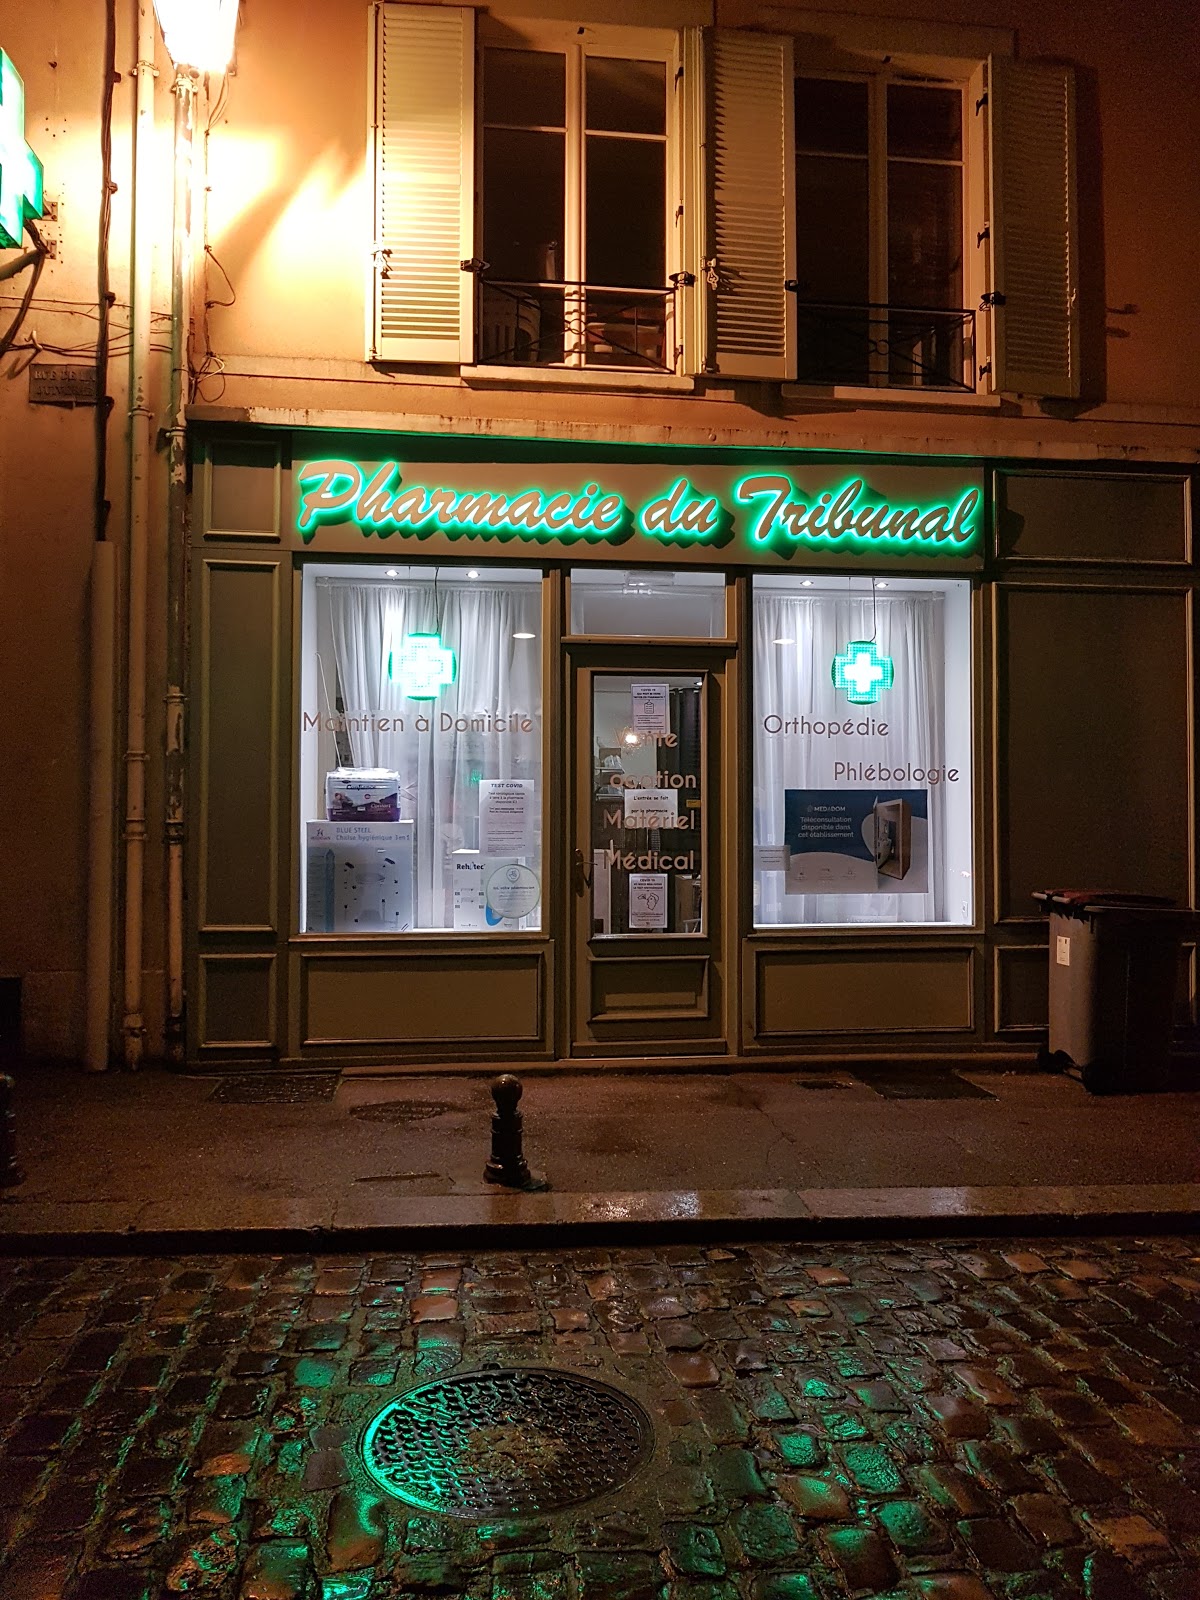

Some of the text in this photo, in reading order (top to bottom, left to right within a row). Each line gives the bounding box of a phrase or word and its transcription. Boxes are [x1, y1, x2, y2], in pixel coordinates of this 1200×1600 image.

[299, 460, 979, 543] Pharmacie du Tribunal
[303, 712, 533, 733] Maintien à Domicile
[763, 714, 889, 738] Orthopédie
[613, 726, 678, 748] Vnte
[834, 762, 959, 785] Phlébologie
[603, 809, 695, 830] Matériel
[603, 849, 694, 870] Médical
